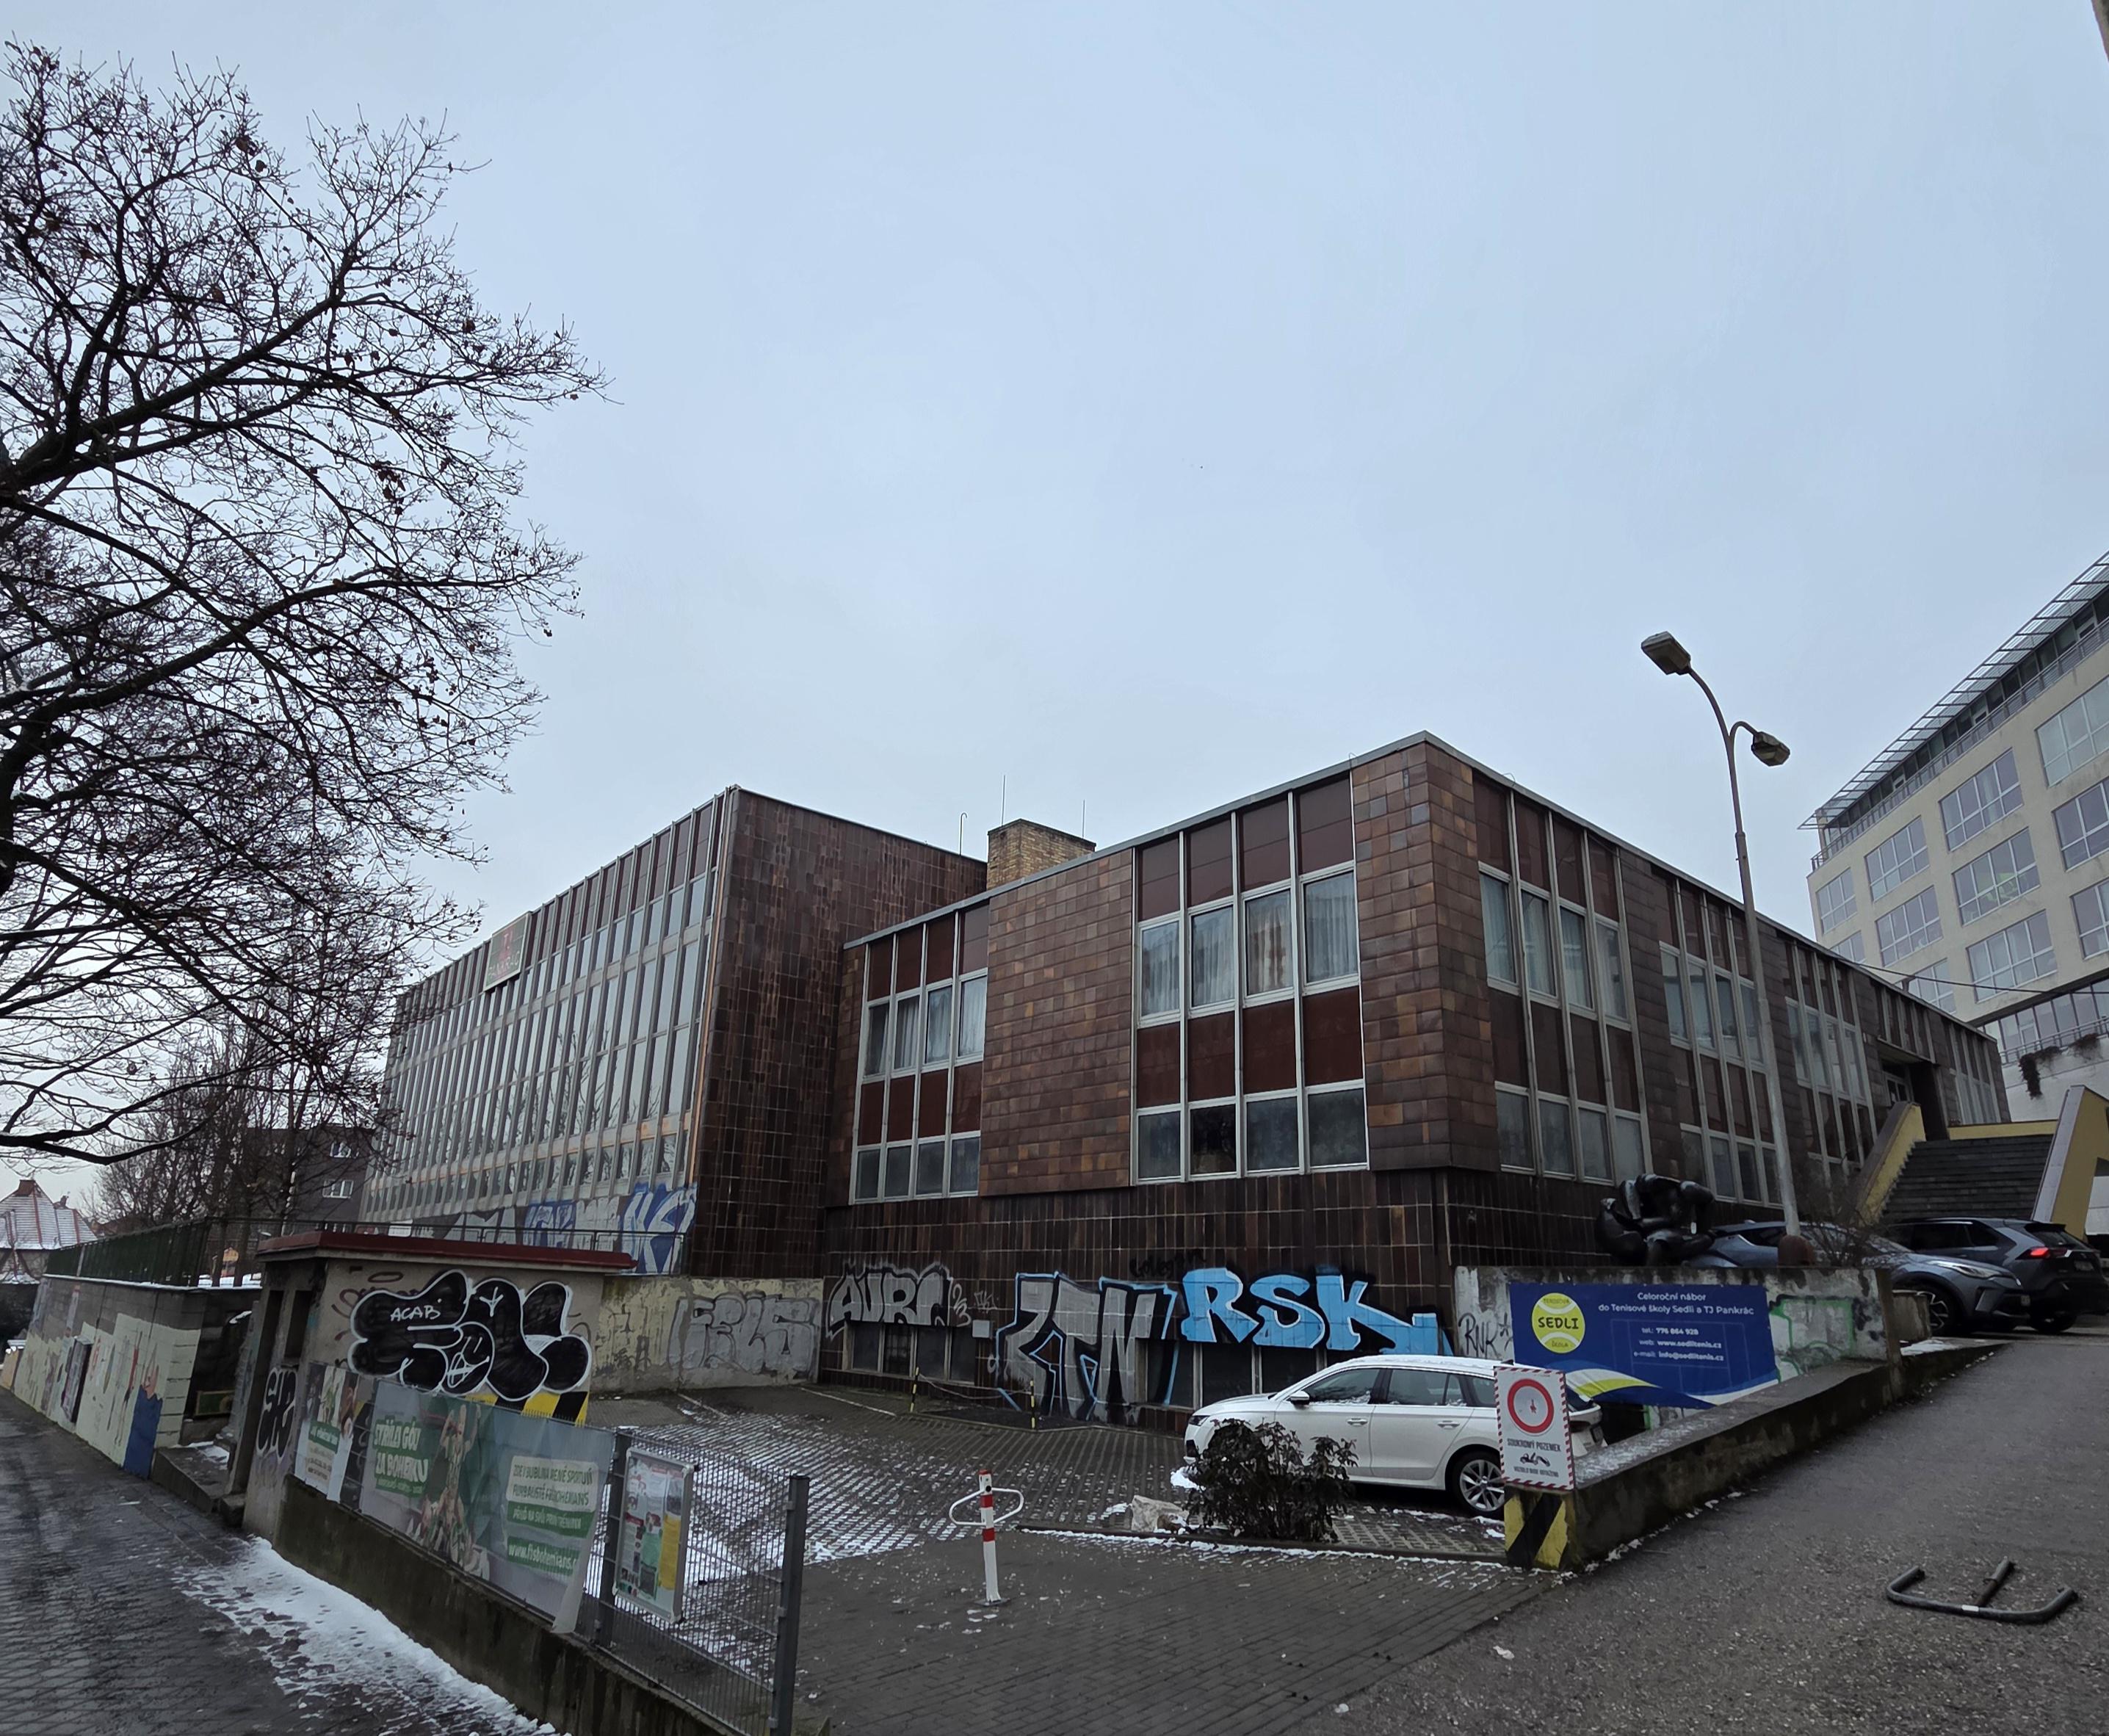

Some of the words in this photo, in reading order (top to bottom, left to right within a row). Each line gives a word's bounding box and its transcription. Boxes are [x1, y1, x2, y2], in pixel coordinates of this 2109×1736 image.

[1637, 1292, 1679, 1301] Celoroční
[1680, 1292, 1706, 1301] nábor
[390, 1304, 441, 1322] ACAB
[1598, 1303, 1610, 1312] do
[1610, 1303, 1646, 1313] Tenisové
[1649, 1303, 1671, 1314] školy
[1672, 1305, 1695, 1314] Sedli
[1704, 1306, 1714, 1314] TJ
[1716, 1306, 1754, 1315] Pankrác
[1538, 1317, 1579, 1329] SEDLI
